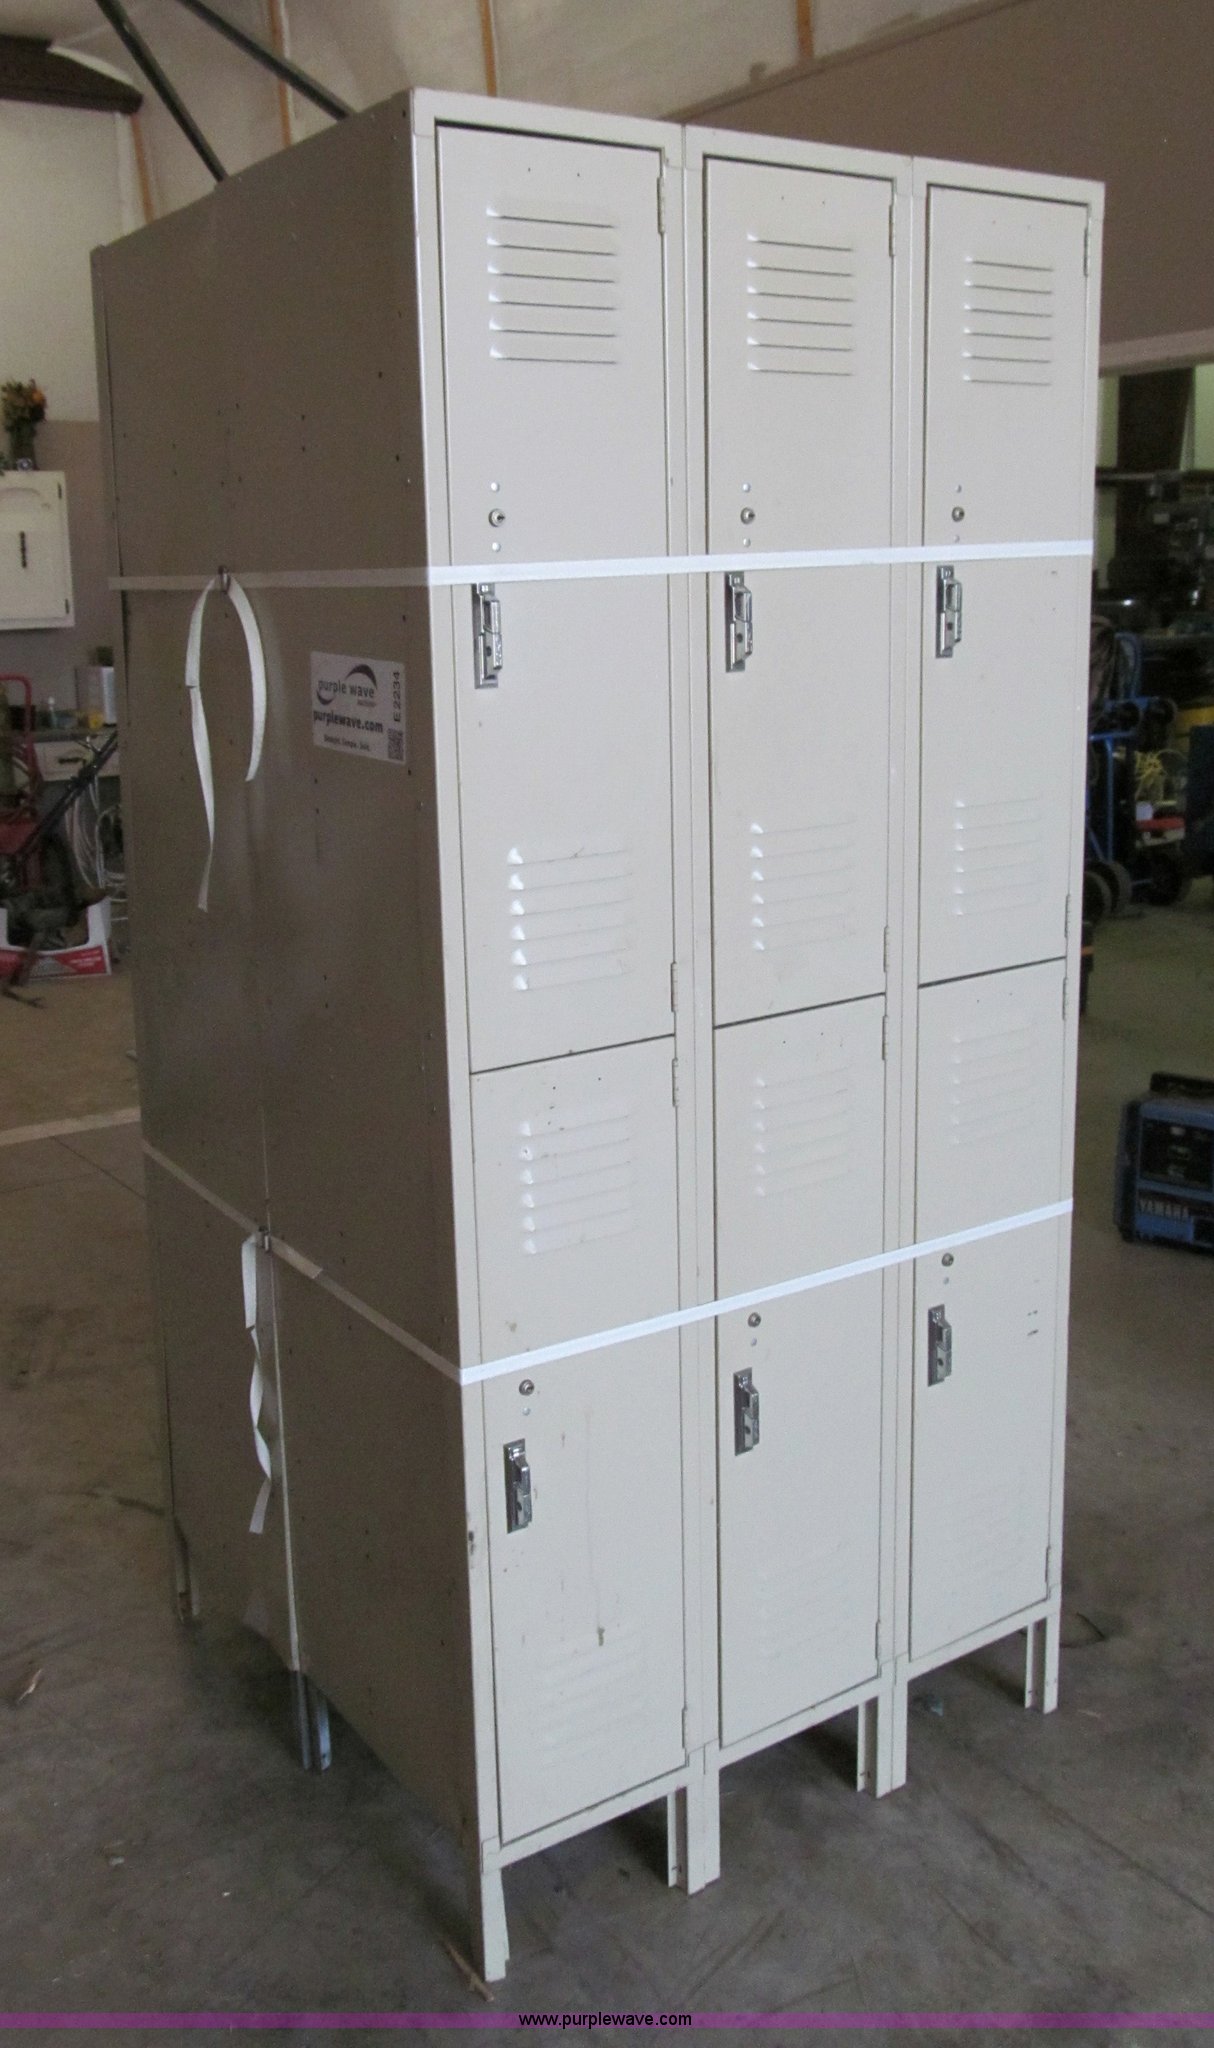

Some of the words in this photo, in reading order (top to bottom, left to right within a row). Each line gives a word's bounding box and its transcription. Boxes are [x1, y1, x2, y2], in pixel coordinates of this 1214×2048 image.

[318, 680, 346, 694] purple
[350, 684, 375, 698] wave
[313, 710, 383, 733] purplewave.com
